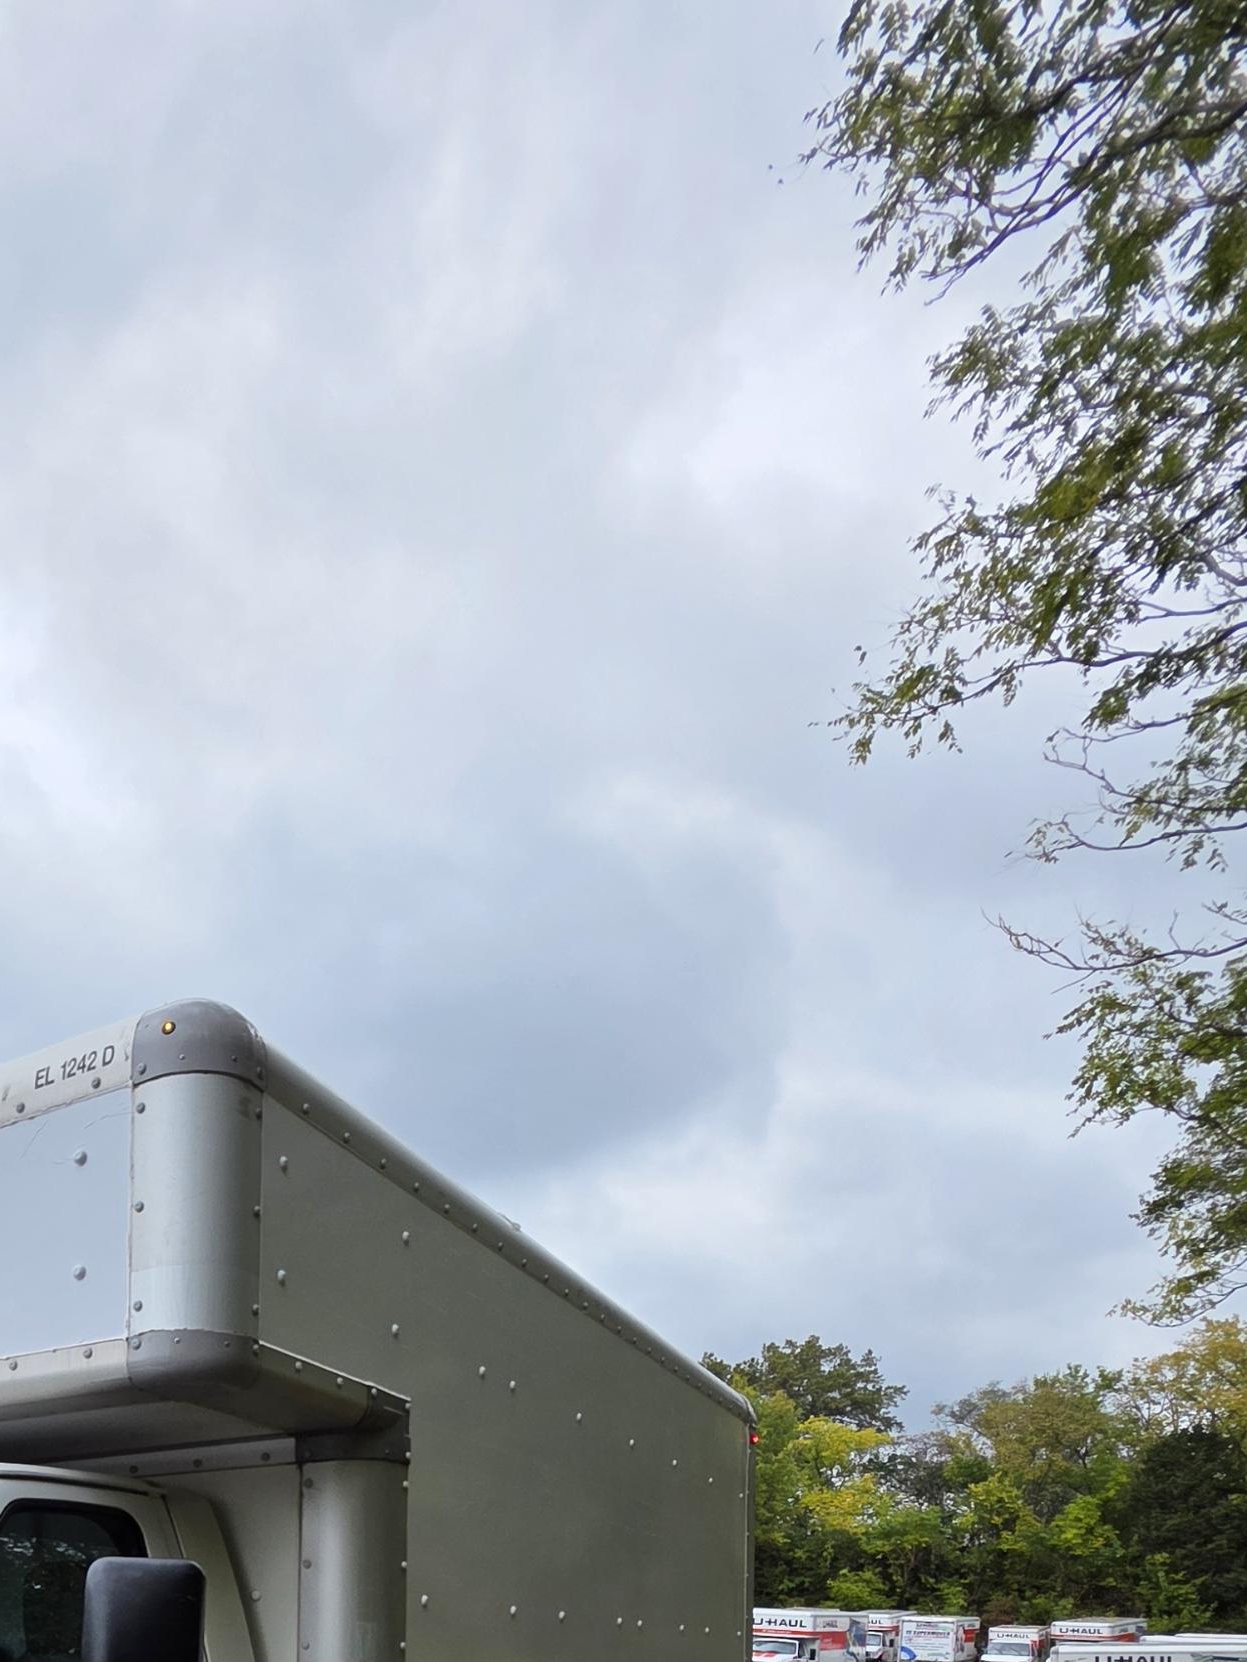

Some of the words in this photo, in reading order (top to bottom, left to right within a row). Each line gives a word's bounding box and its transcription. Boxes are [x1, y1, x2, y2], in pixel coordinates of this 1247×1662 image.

[34, 1066, 55, 1089] EL
[61, 1051, 97, 1080] 1242
[102, 1045, 115, 1067] D
